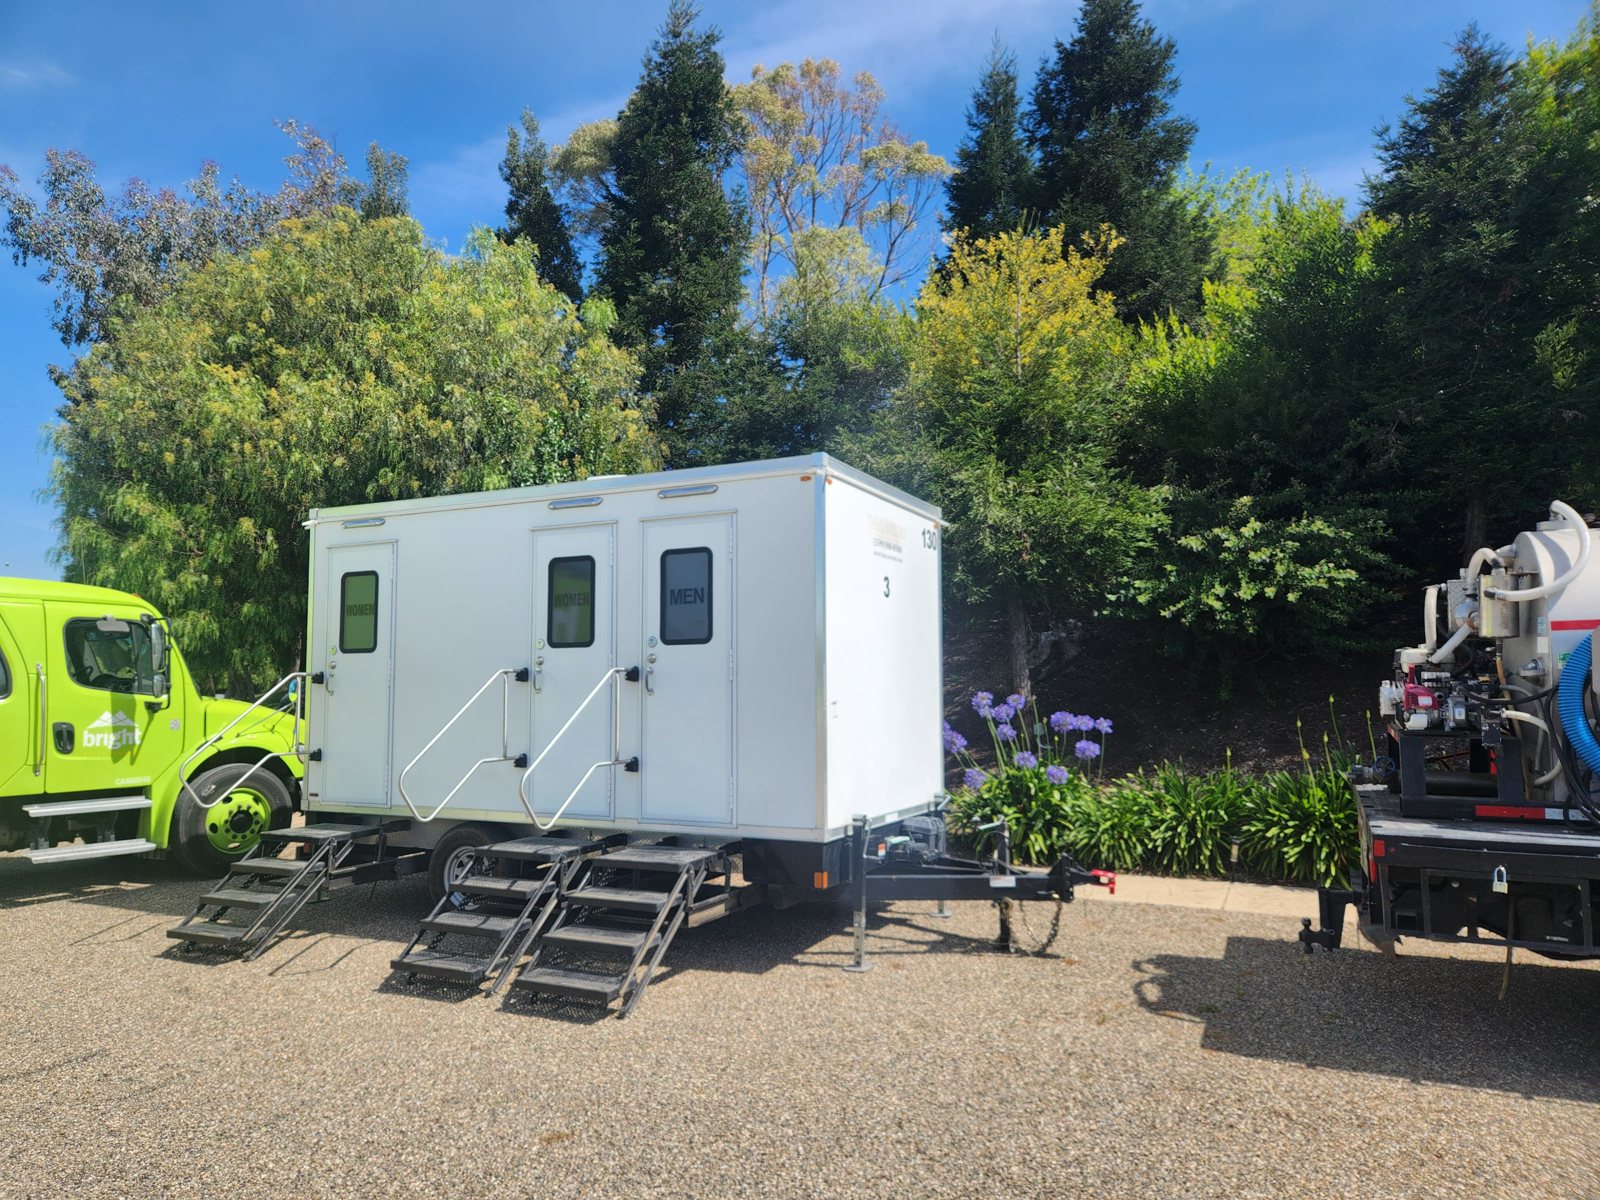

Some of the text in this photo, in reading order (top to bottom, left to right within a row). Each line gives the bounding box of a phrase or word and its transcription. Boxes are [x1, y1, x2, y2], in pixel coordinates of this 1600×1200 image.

[921, 528, 936, 550] 130
[669, 587, 705, 606] MEN
[883, 575, 890, 598] 3
[554, 592, 590, 607] WOMEN
[346, 603, 375, 617] WOMEN
[83, 729, 141, 750] bright
